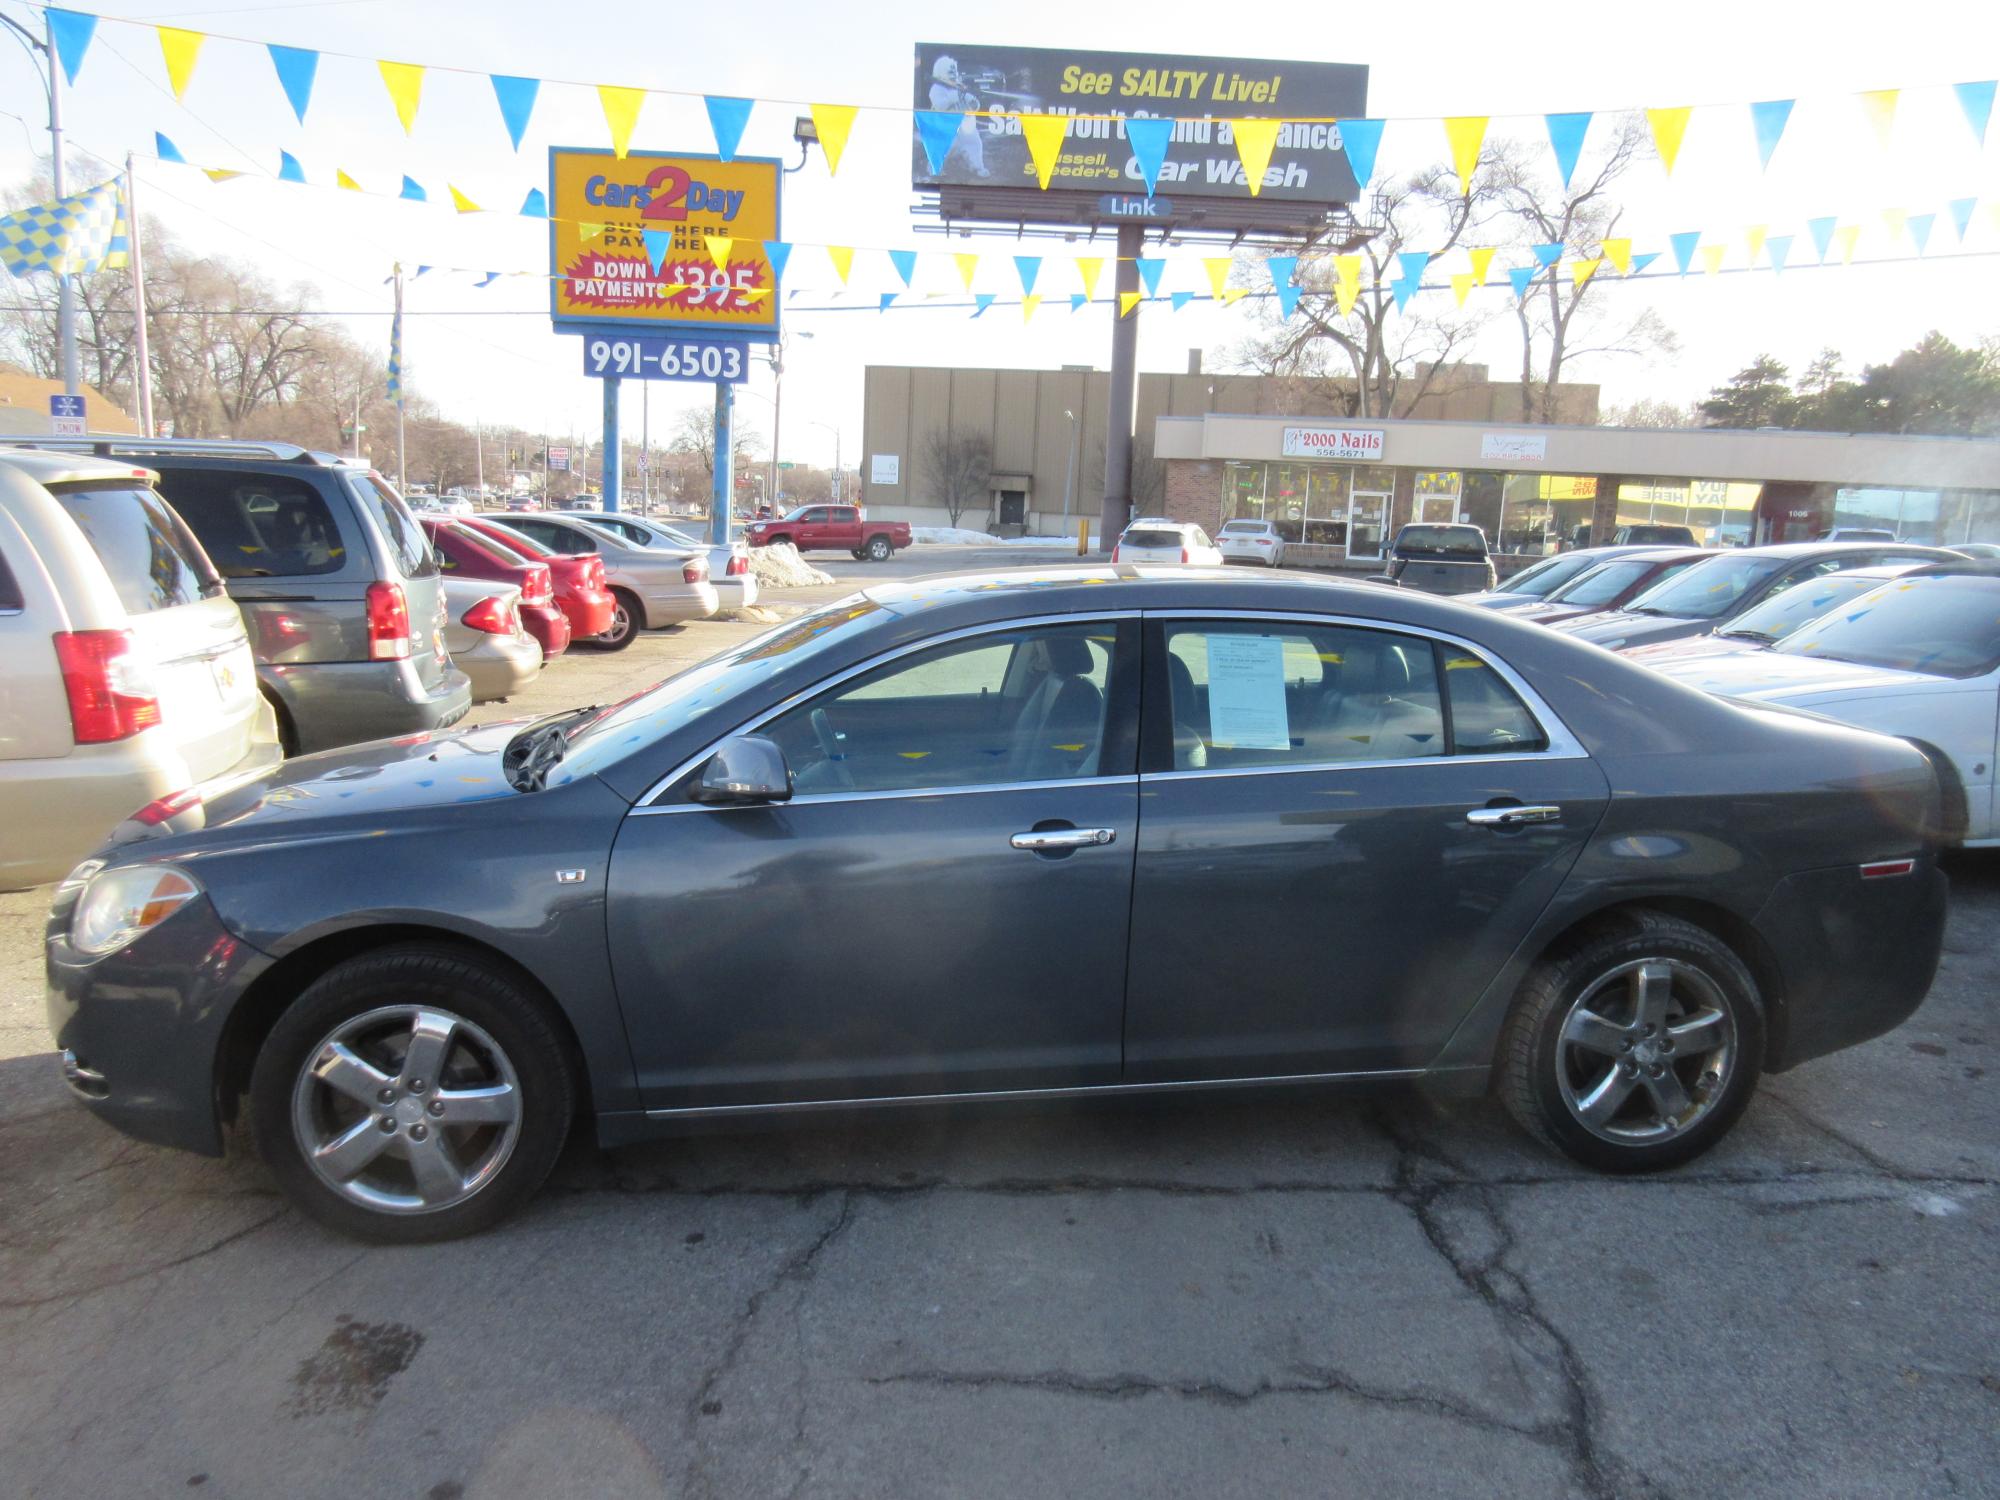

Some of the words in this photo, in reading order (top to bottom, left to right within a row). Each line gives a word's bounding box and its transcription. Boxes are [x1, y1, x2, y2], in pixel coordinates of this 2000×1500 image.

[1060, 65, 1113, 95] See
[1120, 68, 1208, 99] SALTY
[1212, 73, 1281, 103] Live!
[989, 104, 1042, 136] Sa
[1023, 162, 1119, 179] Seeder's
[1055, 153, 1107, 171] ssell
[1111, 194, 1156, 216] Link
[674, 225, 729, 238] HERE
[604, 235, 646, 249] PAY
[594, 261, 646, 279] DOWN
[674, 264, 754, 307] $395
[590, 340, 741, 378] 991-6503
[57, 423, 81, 433] SNOW
[1303, 432, 1337, 448] 2000
[1341, 432, 1380, 449] Nails
[1316, 448, 1365, 458] 556-5671
